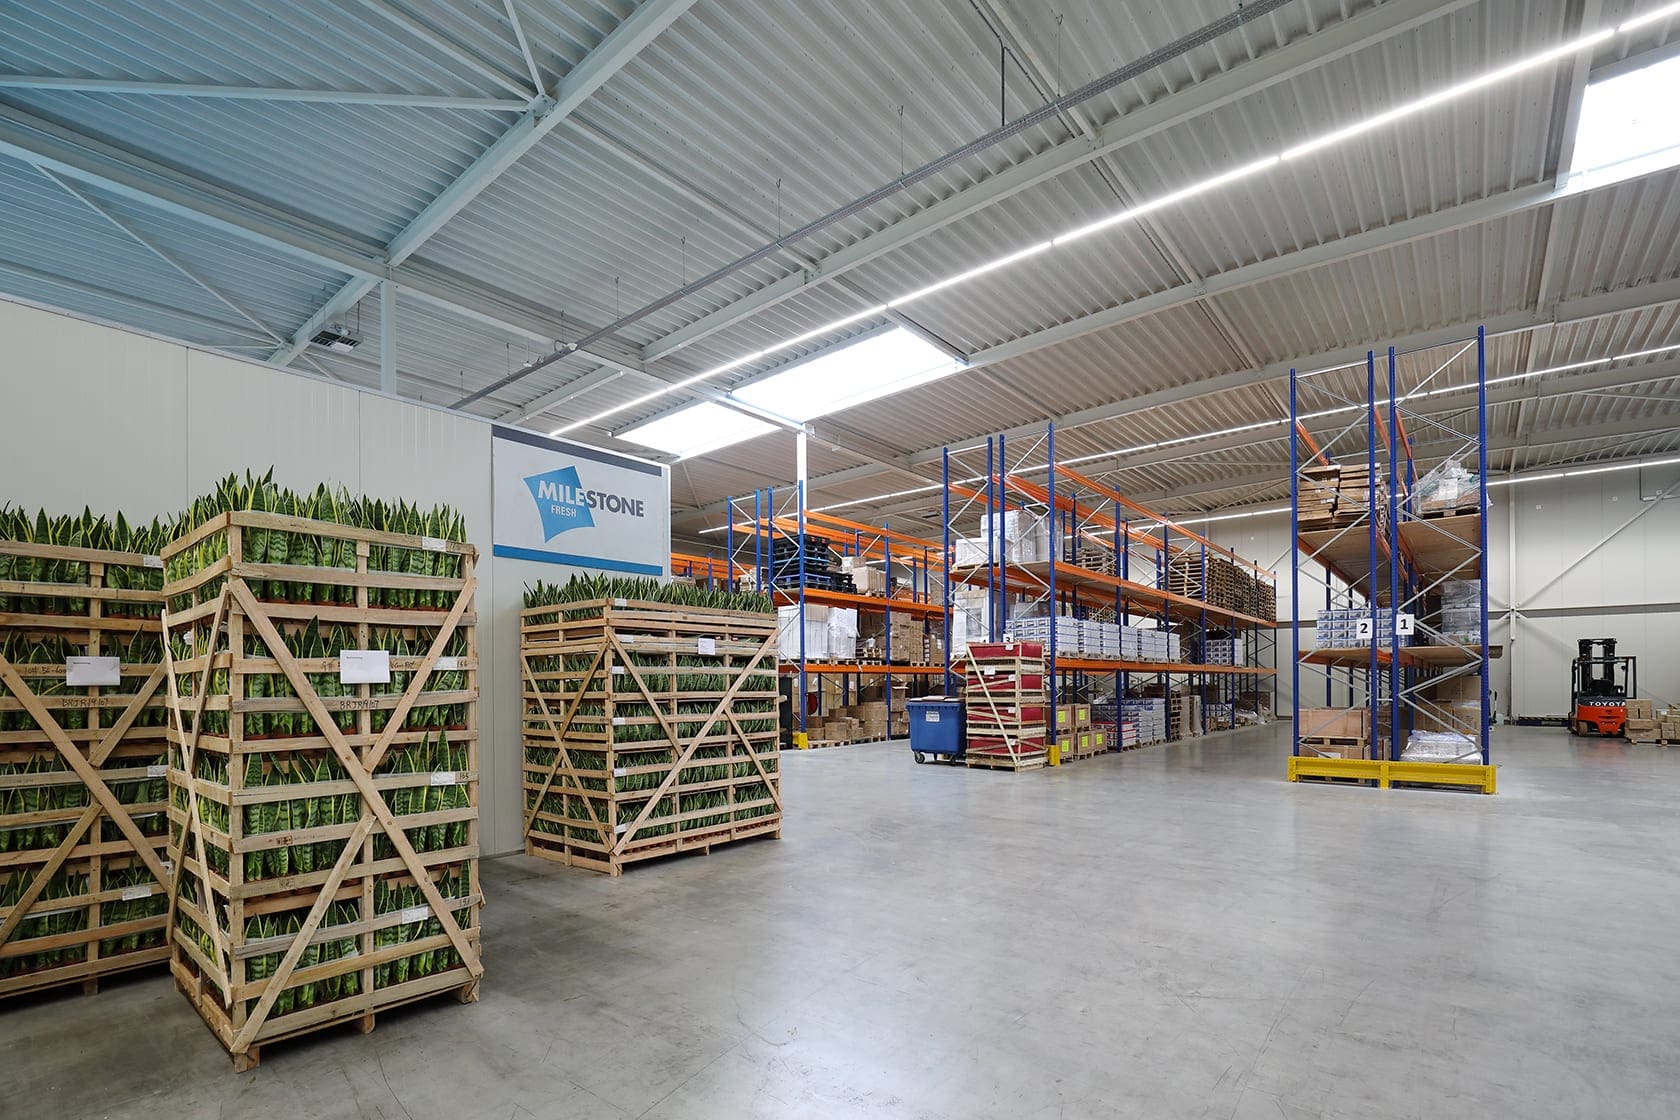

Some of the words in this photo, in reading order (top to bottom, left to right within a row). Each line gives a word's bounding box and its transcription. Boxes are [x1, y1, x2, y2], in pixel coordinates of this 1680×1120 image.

[537, 480, 644, 517] MILESTONE
[551, 504, 577, 518] FRESH
[1360, 622, 1368, 634] 2
[1400, 618, 1408, 630] 1
